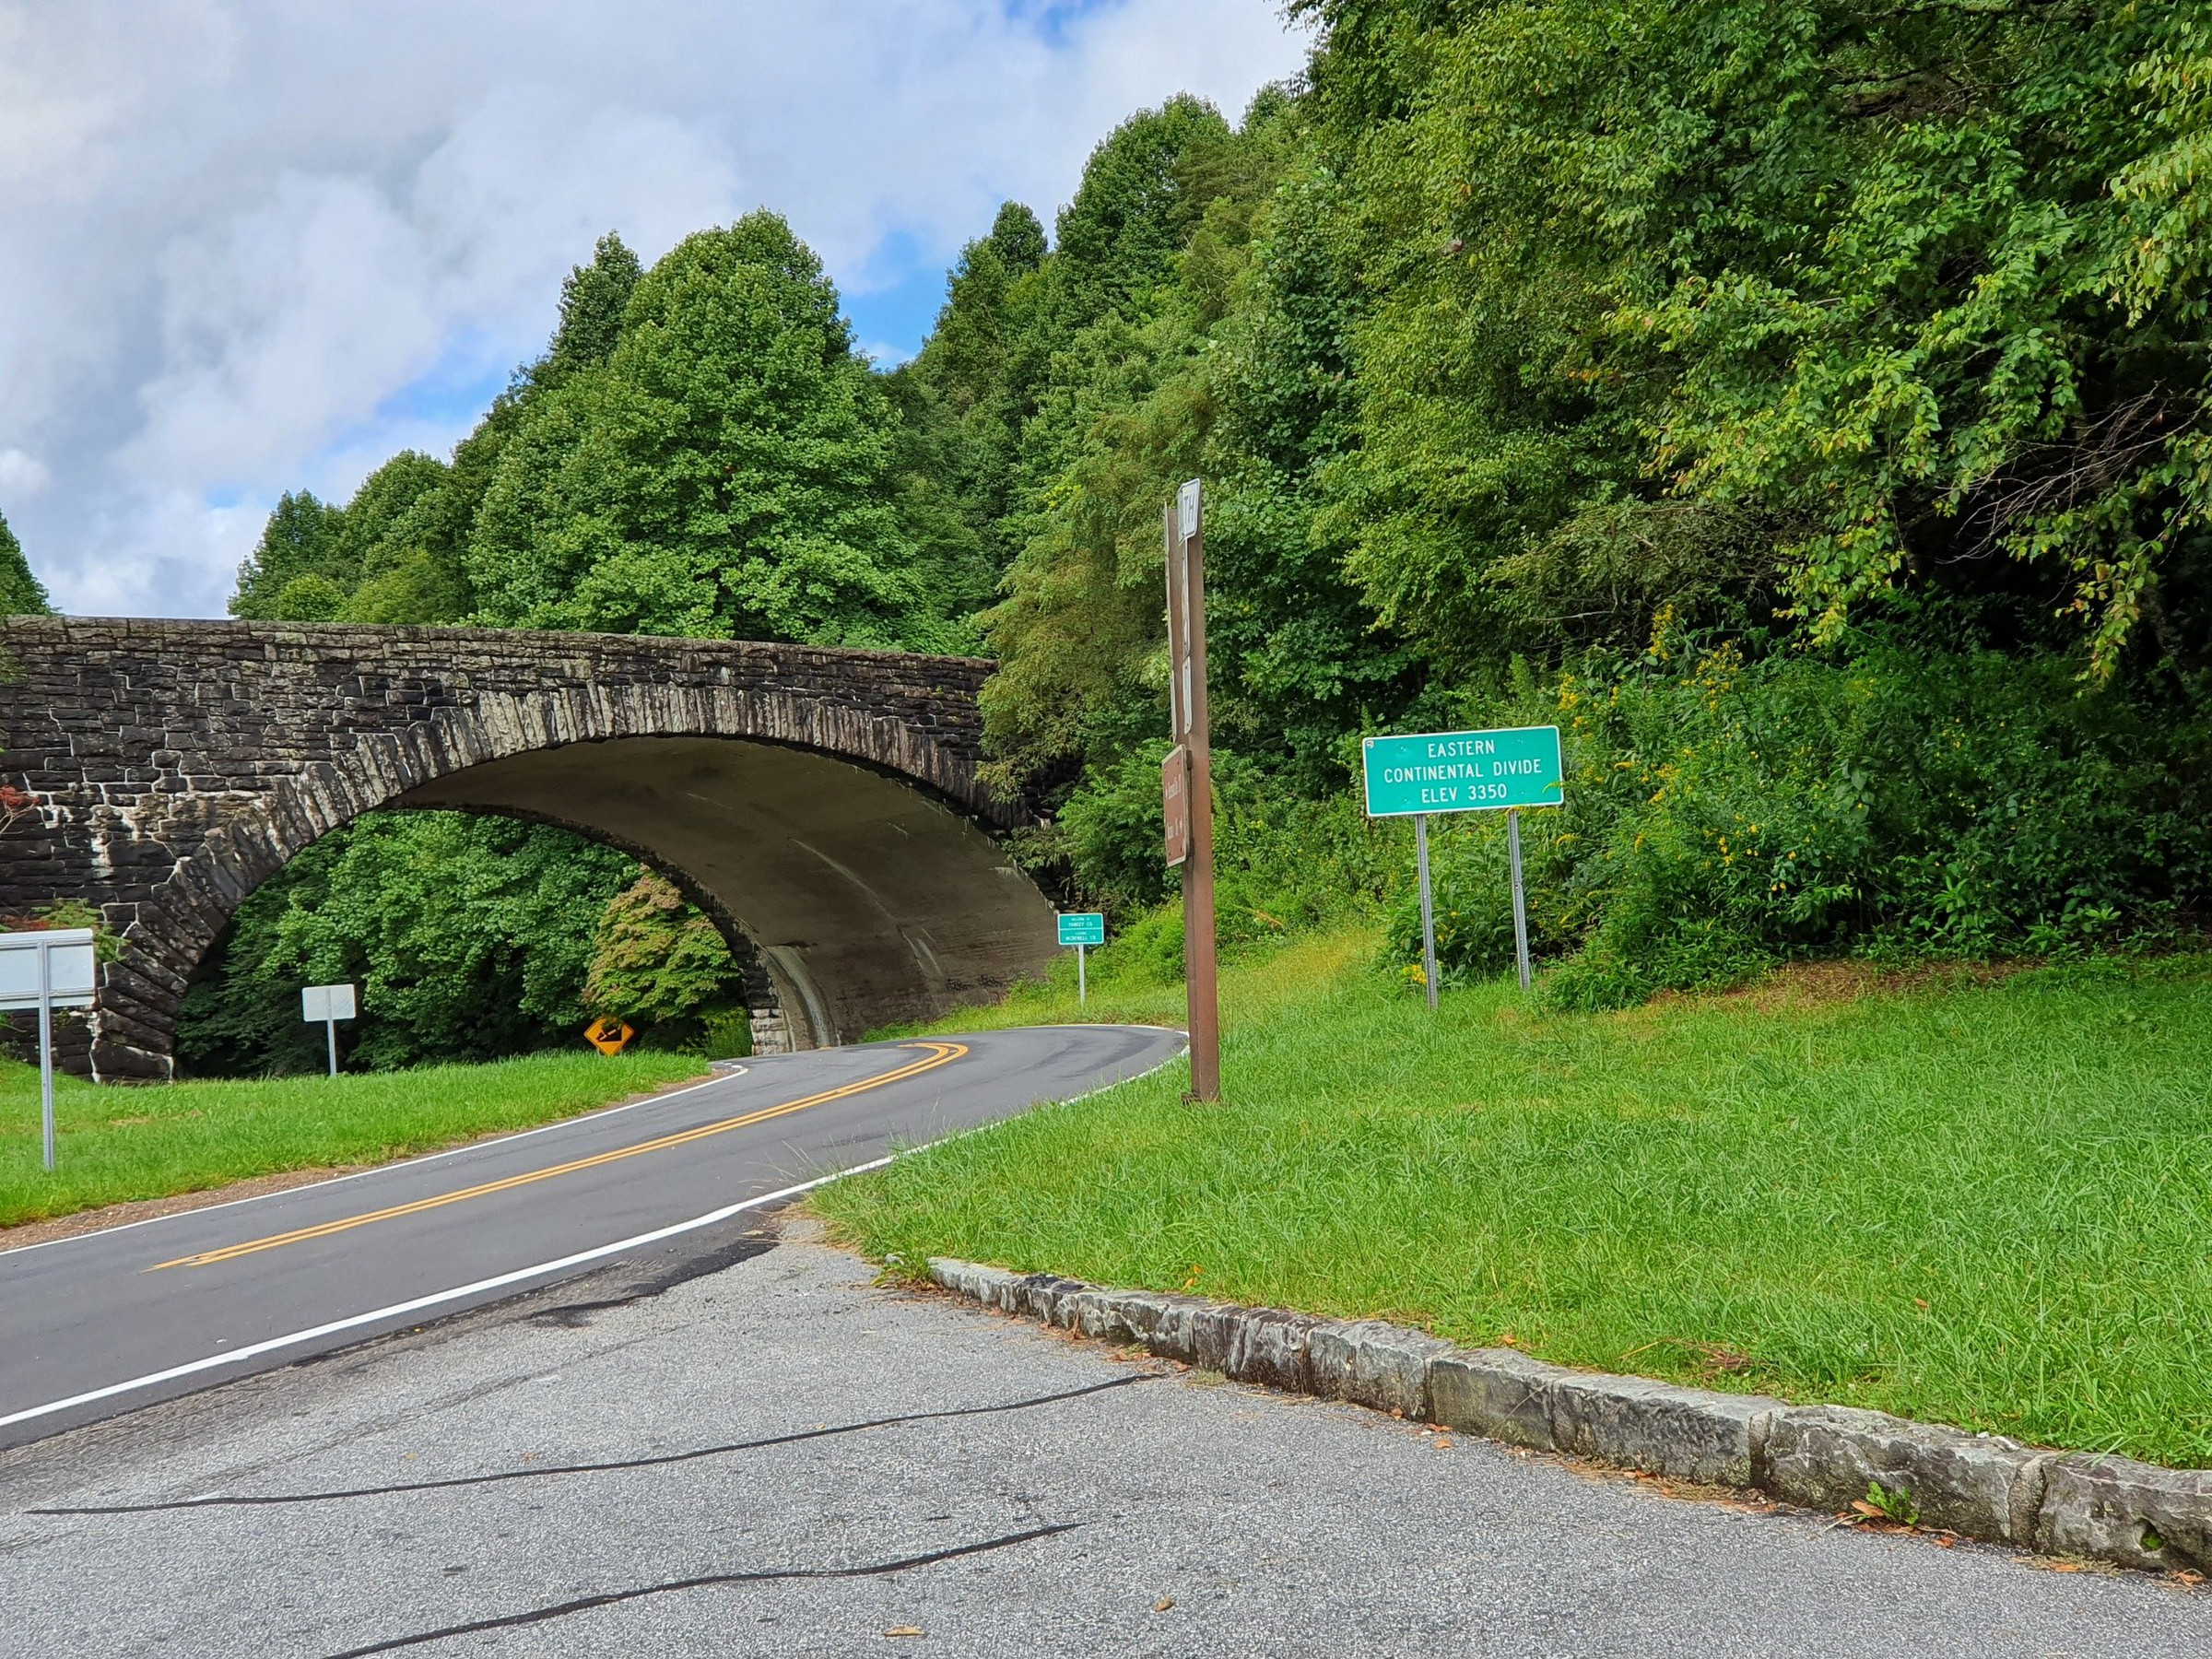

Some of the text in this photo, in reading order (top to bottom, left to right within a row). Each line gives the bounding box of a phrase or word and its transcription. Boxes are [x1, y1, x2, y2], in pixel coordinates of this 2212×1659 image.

[1428, 739, 1495, 759] EASTERN
[1383, 759, 1543, 783] CONTINENTAL DIVIDE
[1421, 783, 1508, 804] ELEV 3350
